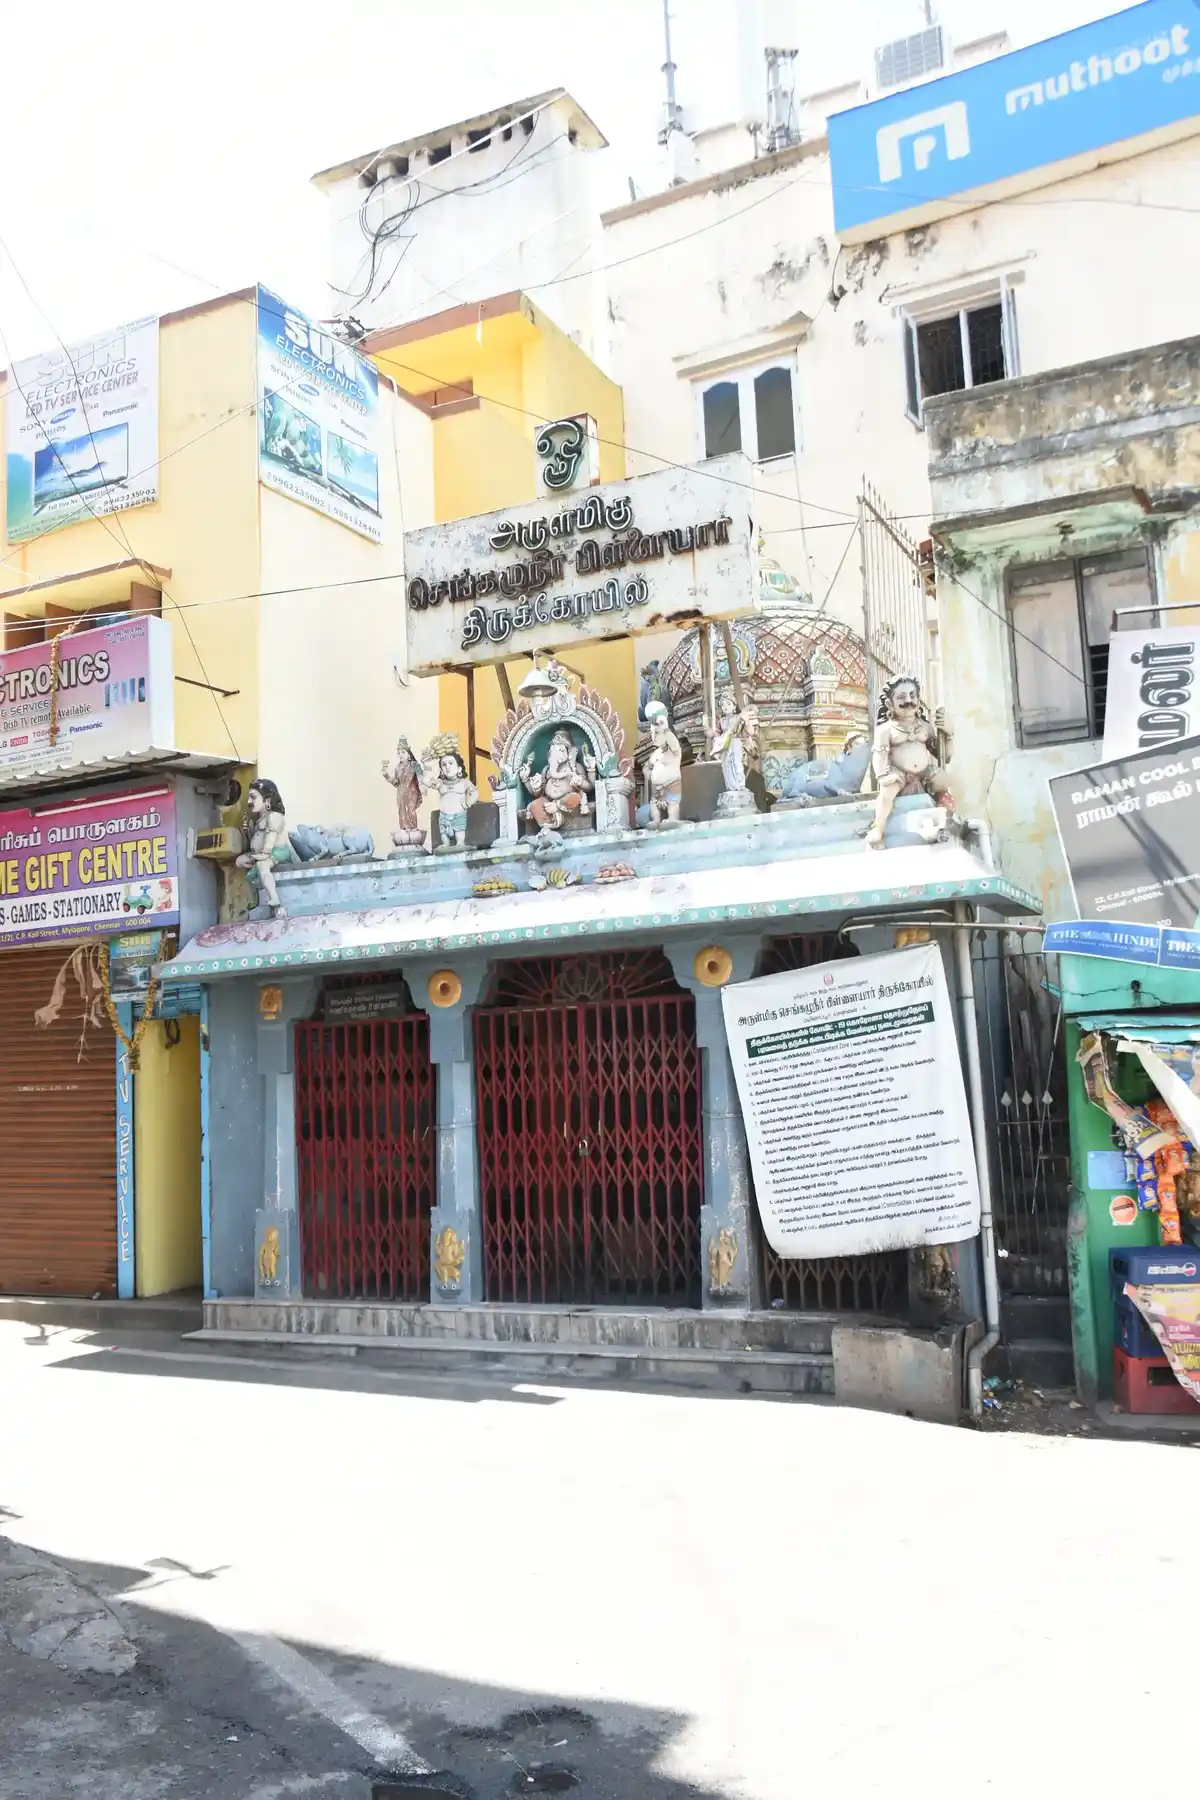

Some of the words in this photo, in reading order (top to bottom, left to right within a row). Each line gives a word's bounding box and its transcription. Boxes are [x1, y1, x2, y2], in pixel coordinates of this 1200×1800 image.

[1004, 23, 1191, 116] muthoot
[26, 357, 138, 404] ELECTRONICS
[101, 370, 140, 393] CENTER
[276, 334, 365, 400] ELECTRONICS
[19, 419, 48, 433] SONY
[102, 402, 139, 418] Panasonic
[489, 495, 634, 552] அருள்மிகு
[575, 508, 733, 576] பிள்ளையார்
[460, 572, 651, 651] திருக்கோயில்
[10, 700, 49, 716] SERVICE
[31, 712, 53, 725] remot
[58, 703, 91, 719] Available
[69, 721, 104, 734] Panasonic
[1071, 776, 1136, 805] RAMAN
[1139, 762, 1189, 785] COOL
[48, 806, 161, 843] பொருளகம்
[1076, 795, 1141, 829] ராமன்
[25, 850, 72, 892] GIFT
[78, 836, 168, 885] CENTRE
[1051, 928, 1079, 940] THE
[1112, 931, 1159, 949] HINDU
[1166, 939, 1196, 953] THE
[738, 1007, 778, 1027] அருள்மிகு
[826, 988, 877, 1009] பிள்ளையார்
[119, 1113, 131, 1262] SERVICE
